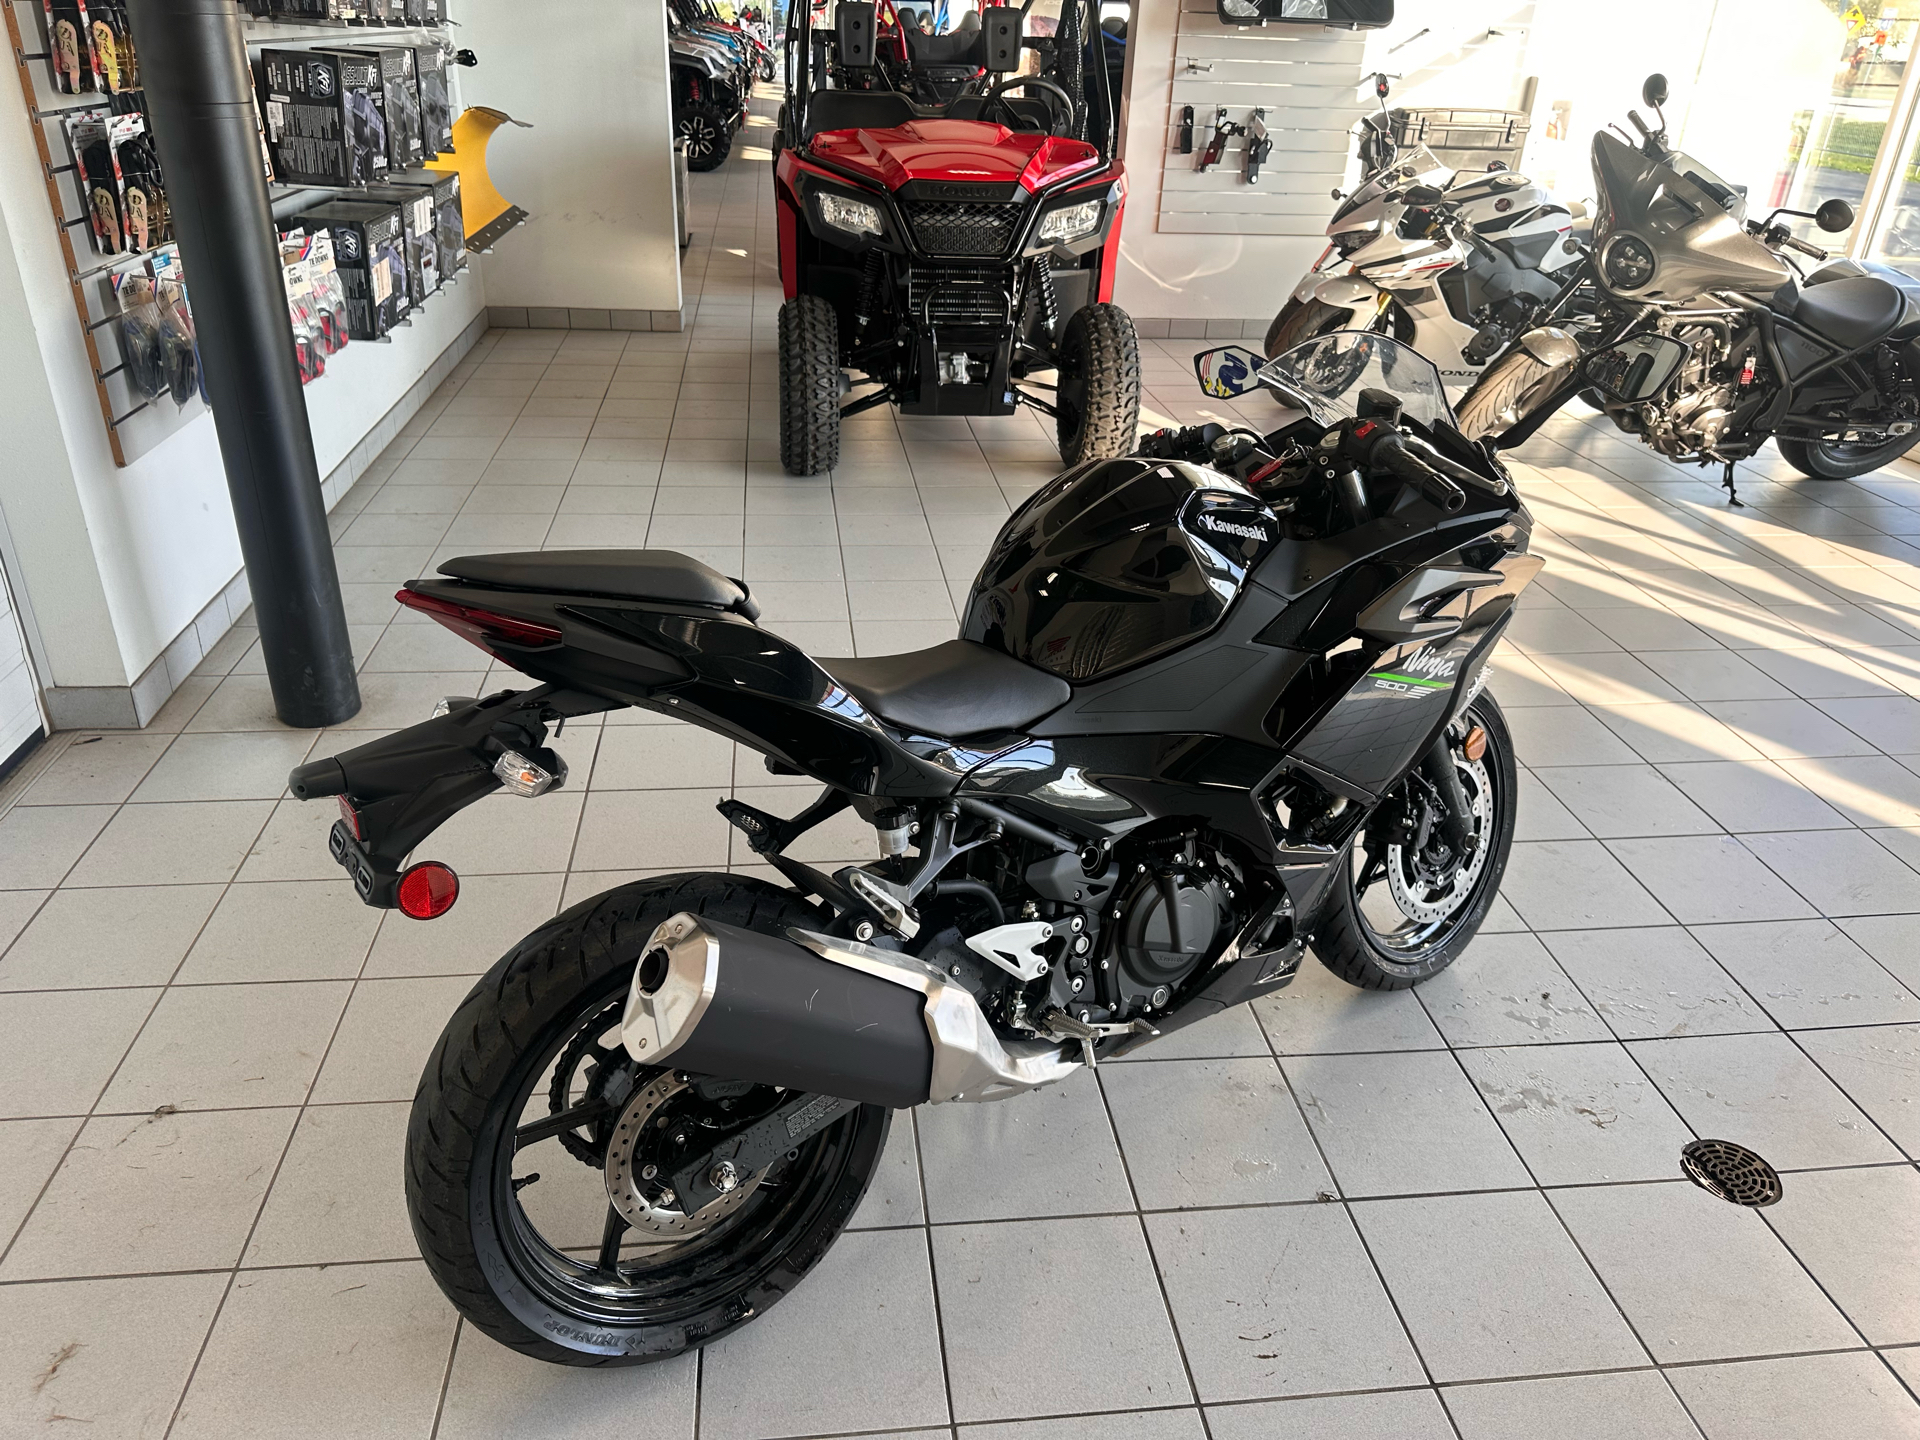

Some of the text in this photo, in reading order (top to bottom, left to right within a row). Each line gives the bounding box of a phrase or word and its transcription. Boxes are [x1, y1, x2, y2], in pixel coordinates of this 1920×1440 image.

[341, 62, 368, 86] ASSAULT
[927, 185, 1004, 197] HONDA
[1801, 340, 1825, 357] 1100
[1205, 514, 1268, 541] Kawasaki
[1402, 646, 1455, 682] Ninja
[1374, 679, 1408, 692] 500
[543, 1320, 624, 1347] DUNLOP
